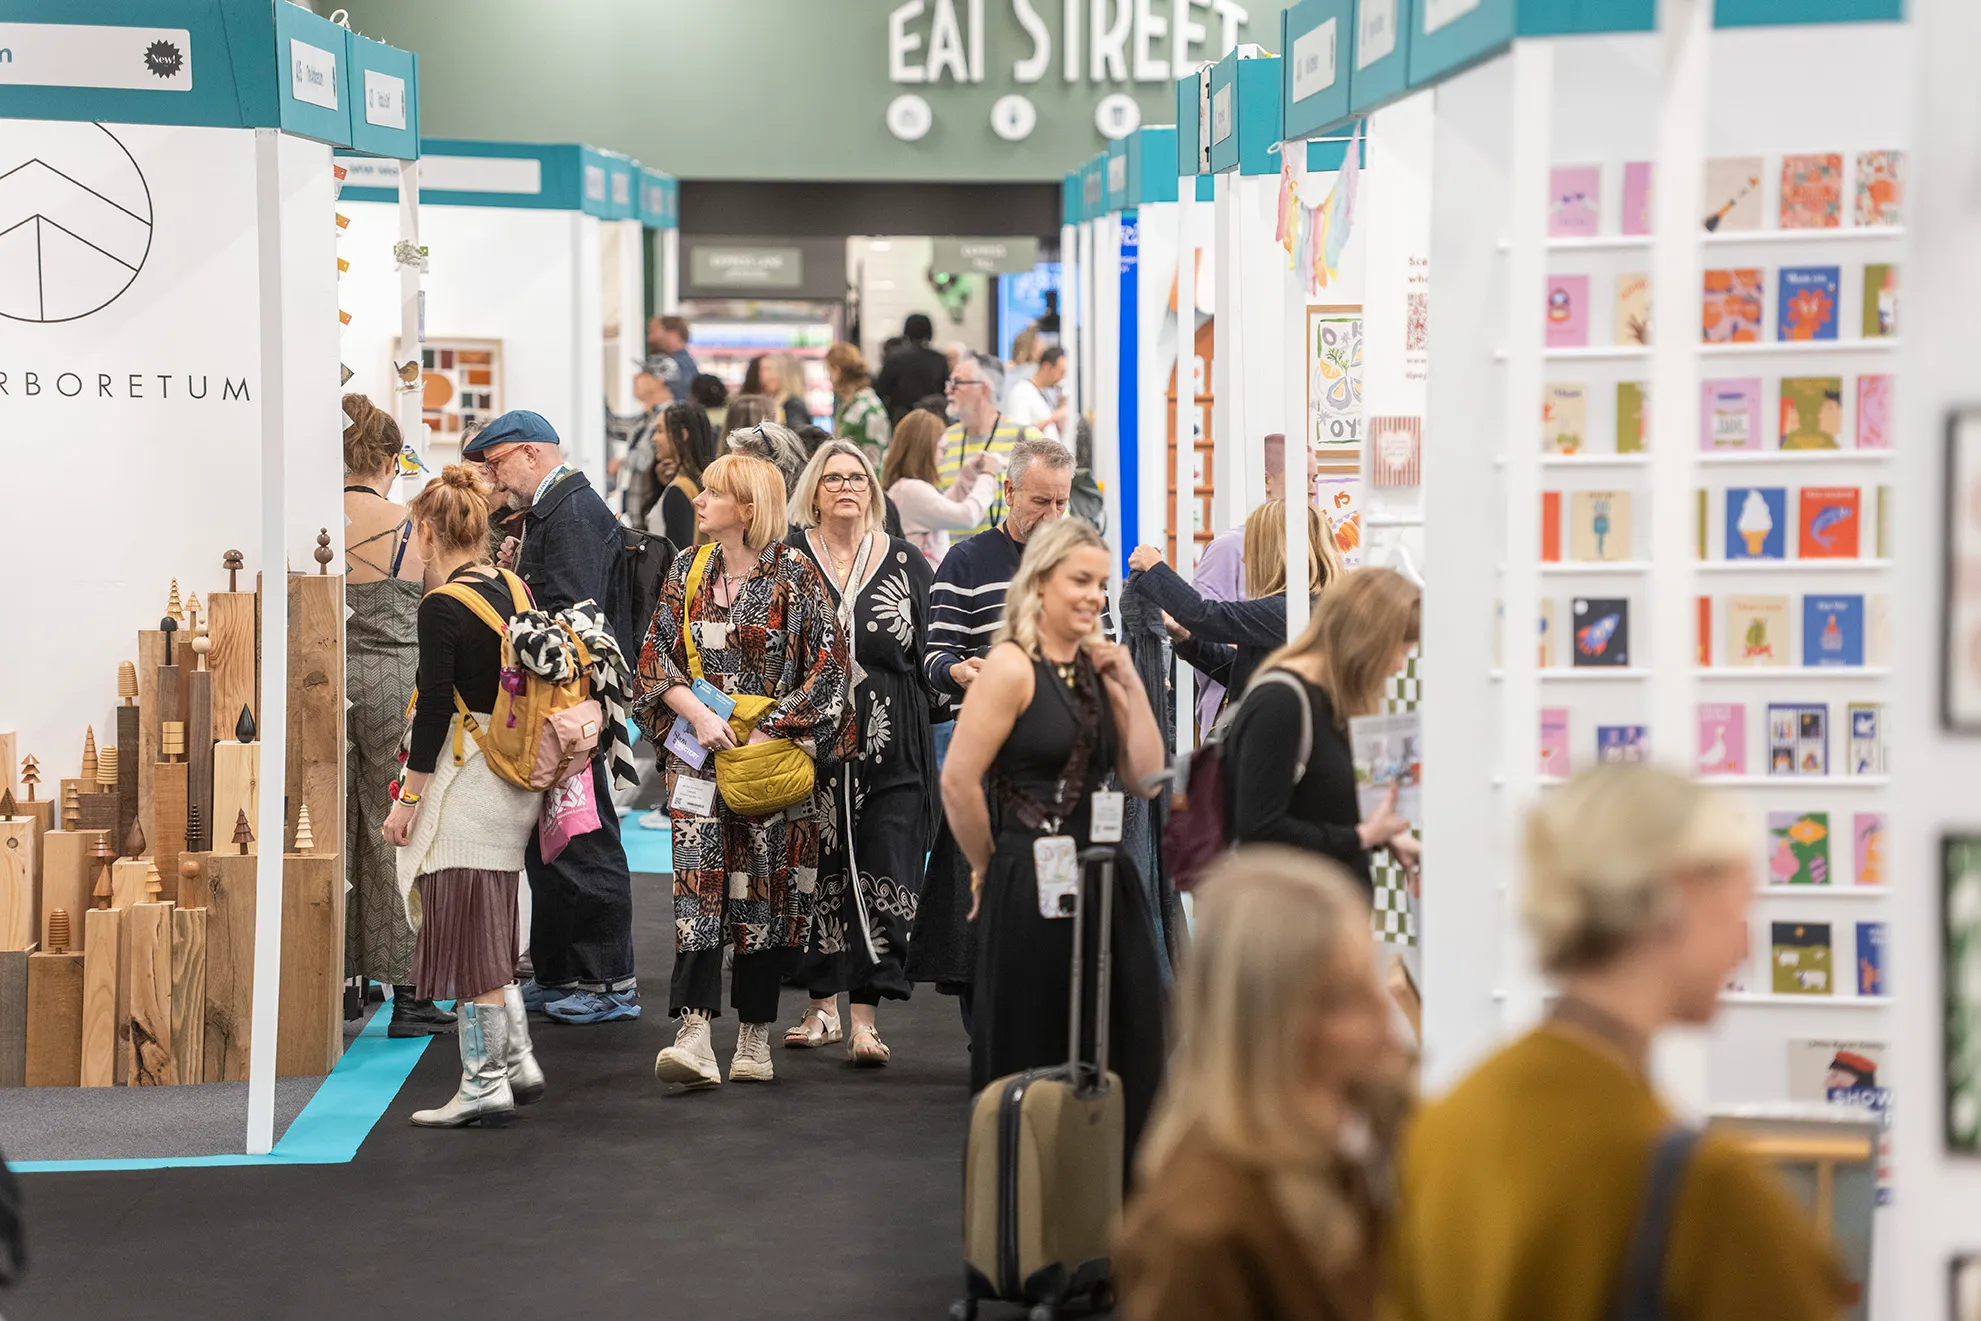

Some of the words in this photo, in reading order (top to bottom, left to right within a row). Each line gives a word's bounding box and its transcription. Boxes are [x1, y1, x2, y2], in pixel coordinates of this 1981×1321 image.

[1009, 0, 1249, 83] STREET
[151, 54, 176, 64] New!
[0, 371, 250, 401] RBORETUM
